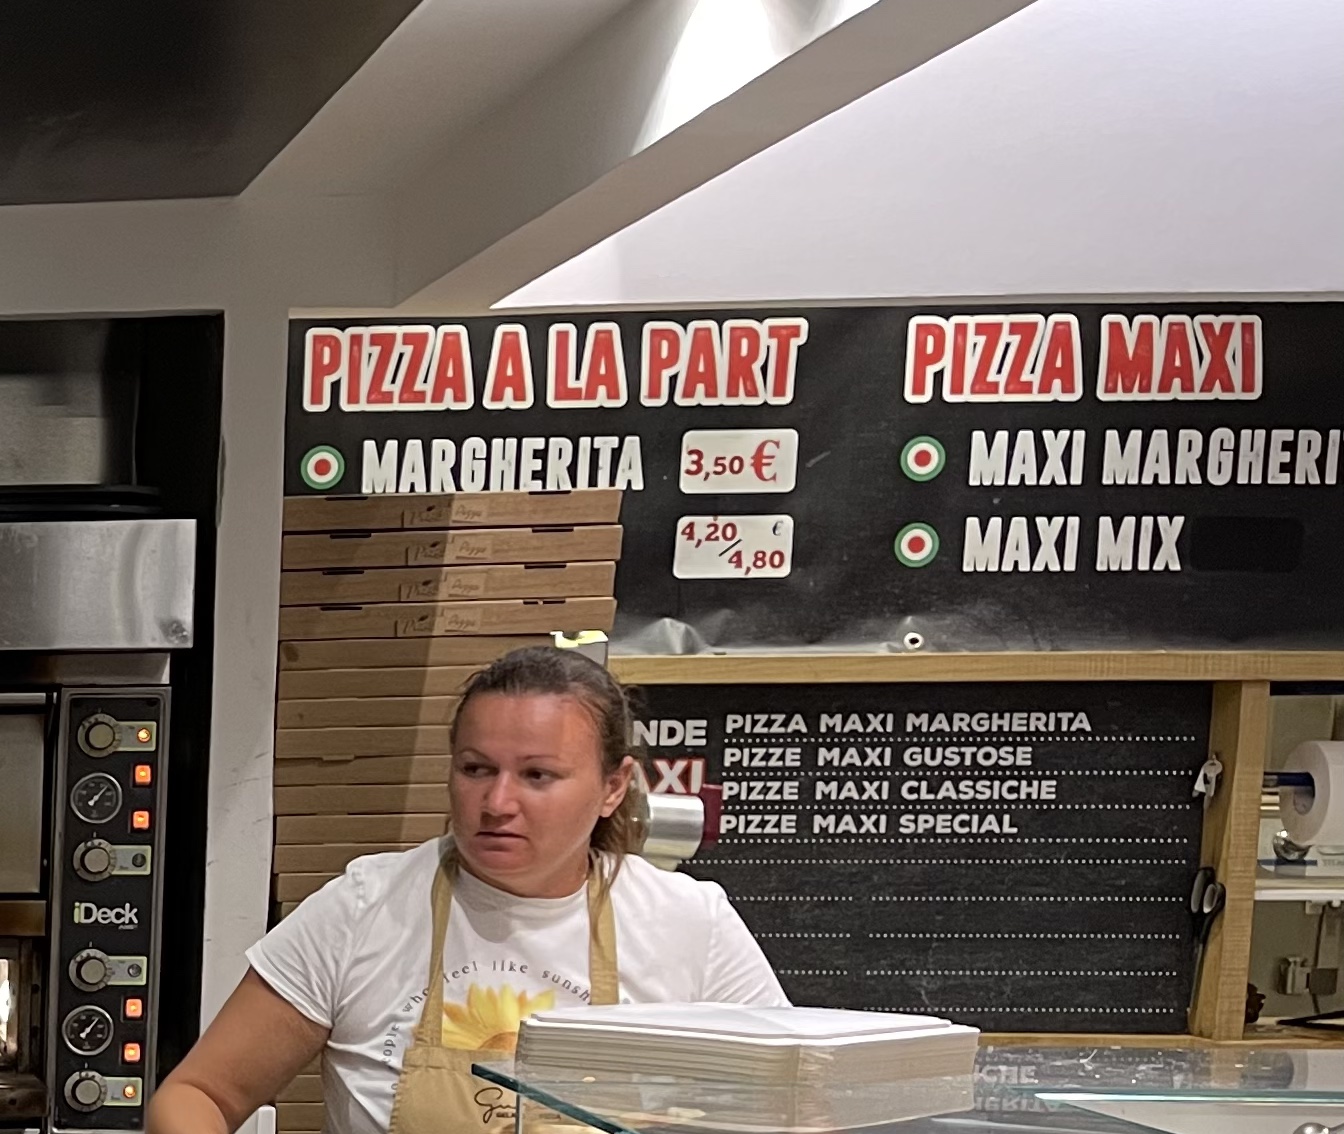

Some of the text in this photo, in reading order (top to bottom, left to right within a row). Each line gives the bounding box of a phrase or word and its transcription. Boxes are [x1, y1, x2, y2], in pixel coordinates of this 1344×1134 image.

[305, 318, 808, 411] PIZZA A LA PART
[905, 314, 1261, 402] PIZZA MAXI
[361, 436, 645, 494] MARGHERITA
[968, 427, 1344, 486] MAXI MARGHERI
[962, 515, 1185, 572] MAXI MIX
[631, 719, 708, 747] NDE
[725, 712, 1092, 734] PIZZA MAXI MARGHERITA
[723, 746, 1033, 768] PIZZE MAXI GUSTOSE
[721, 780, 1058, 801] PIZZE MAXI CLASSICHE
[719, 814, 1018, 835] PIZZE MAXI SPECIAL
[73, 902, 139, 924] iDeck
[492, 959, 529, 974] like
[542, 969, 592, 1005] sunsh
